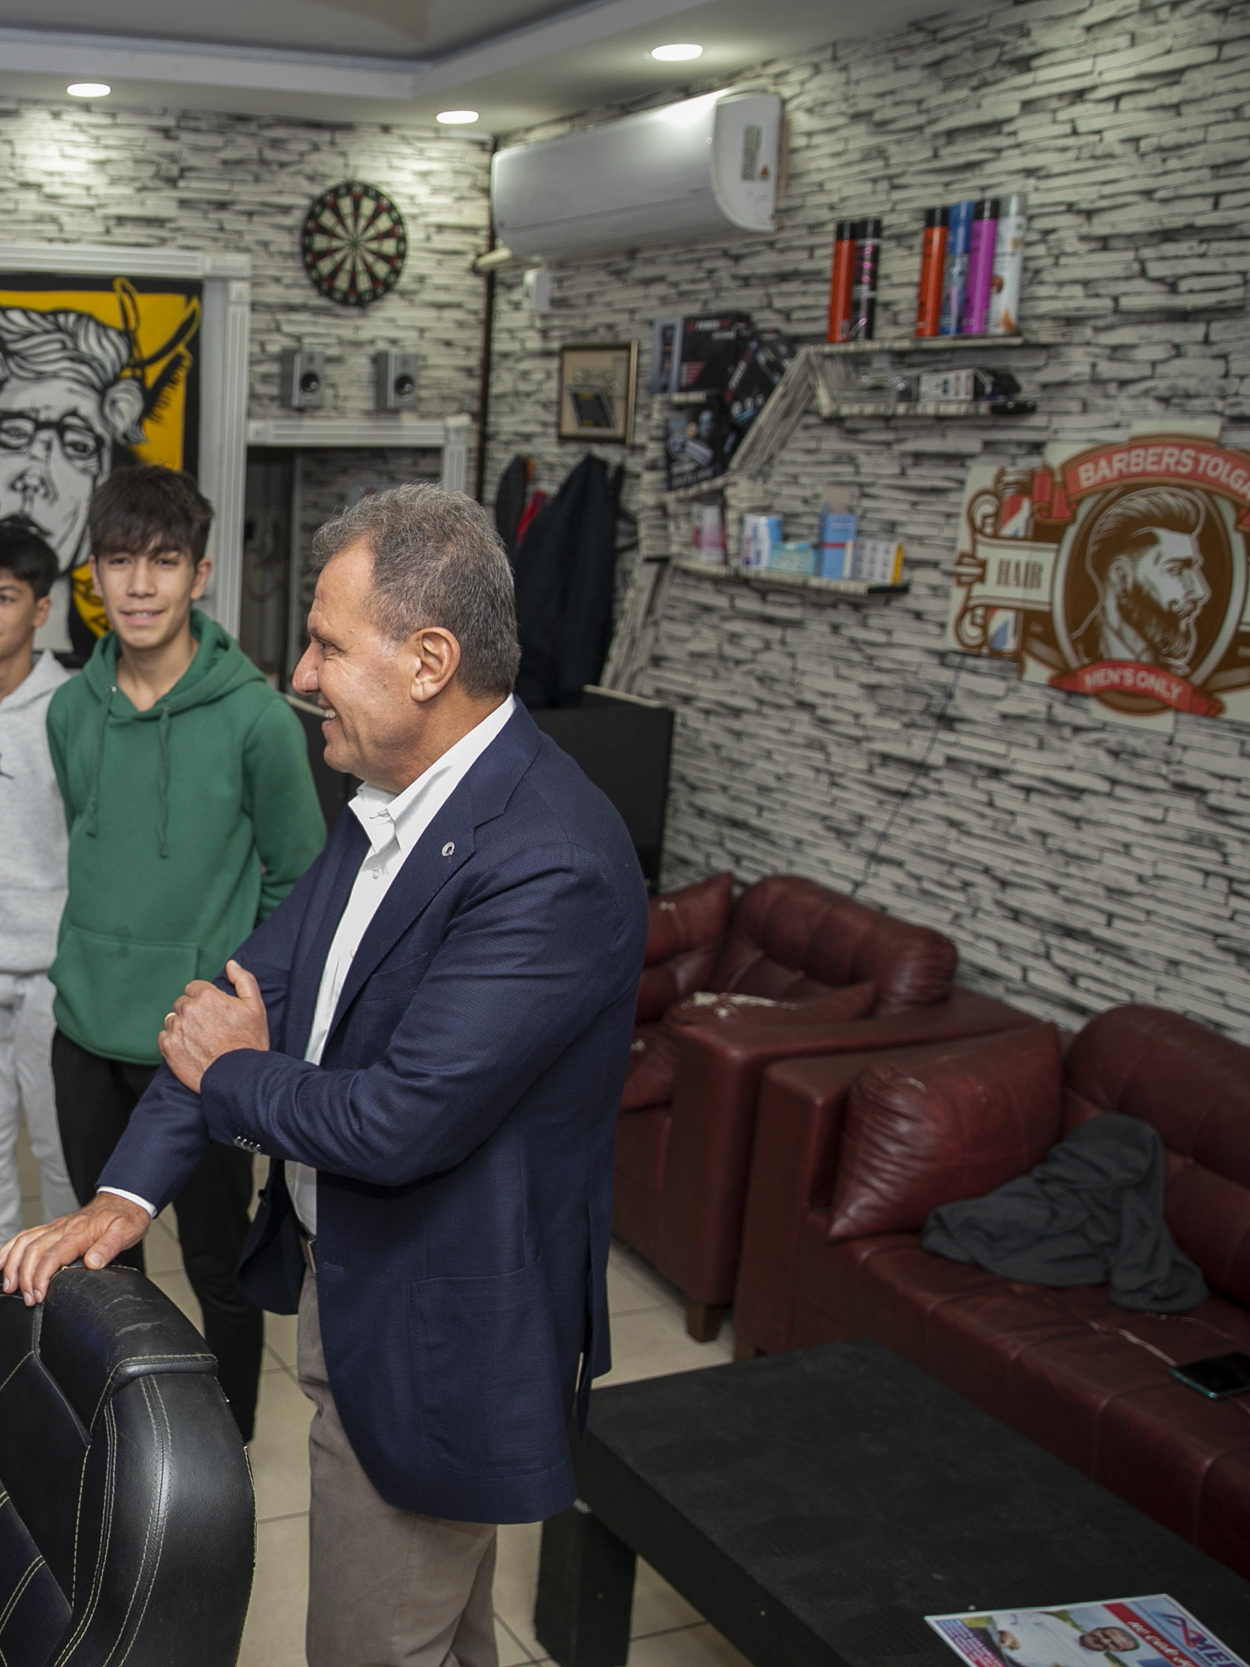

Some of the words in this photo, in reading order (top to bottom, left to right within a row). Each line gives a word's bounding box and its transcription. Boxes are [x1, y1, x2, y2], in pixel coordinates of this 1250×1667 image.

[1078, 446, 1195, 488] BARBERS
[996, 558, 1043, 591] HAIR
[1083, 667, 1135, 691] MEN'S
[1135, 670, 1184, 700] ONLY
